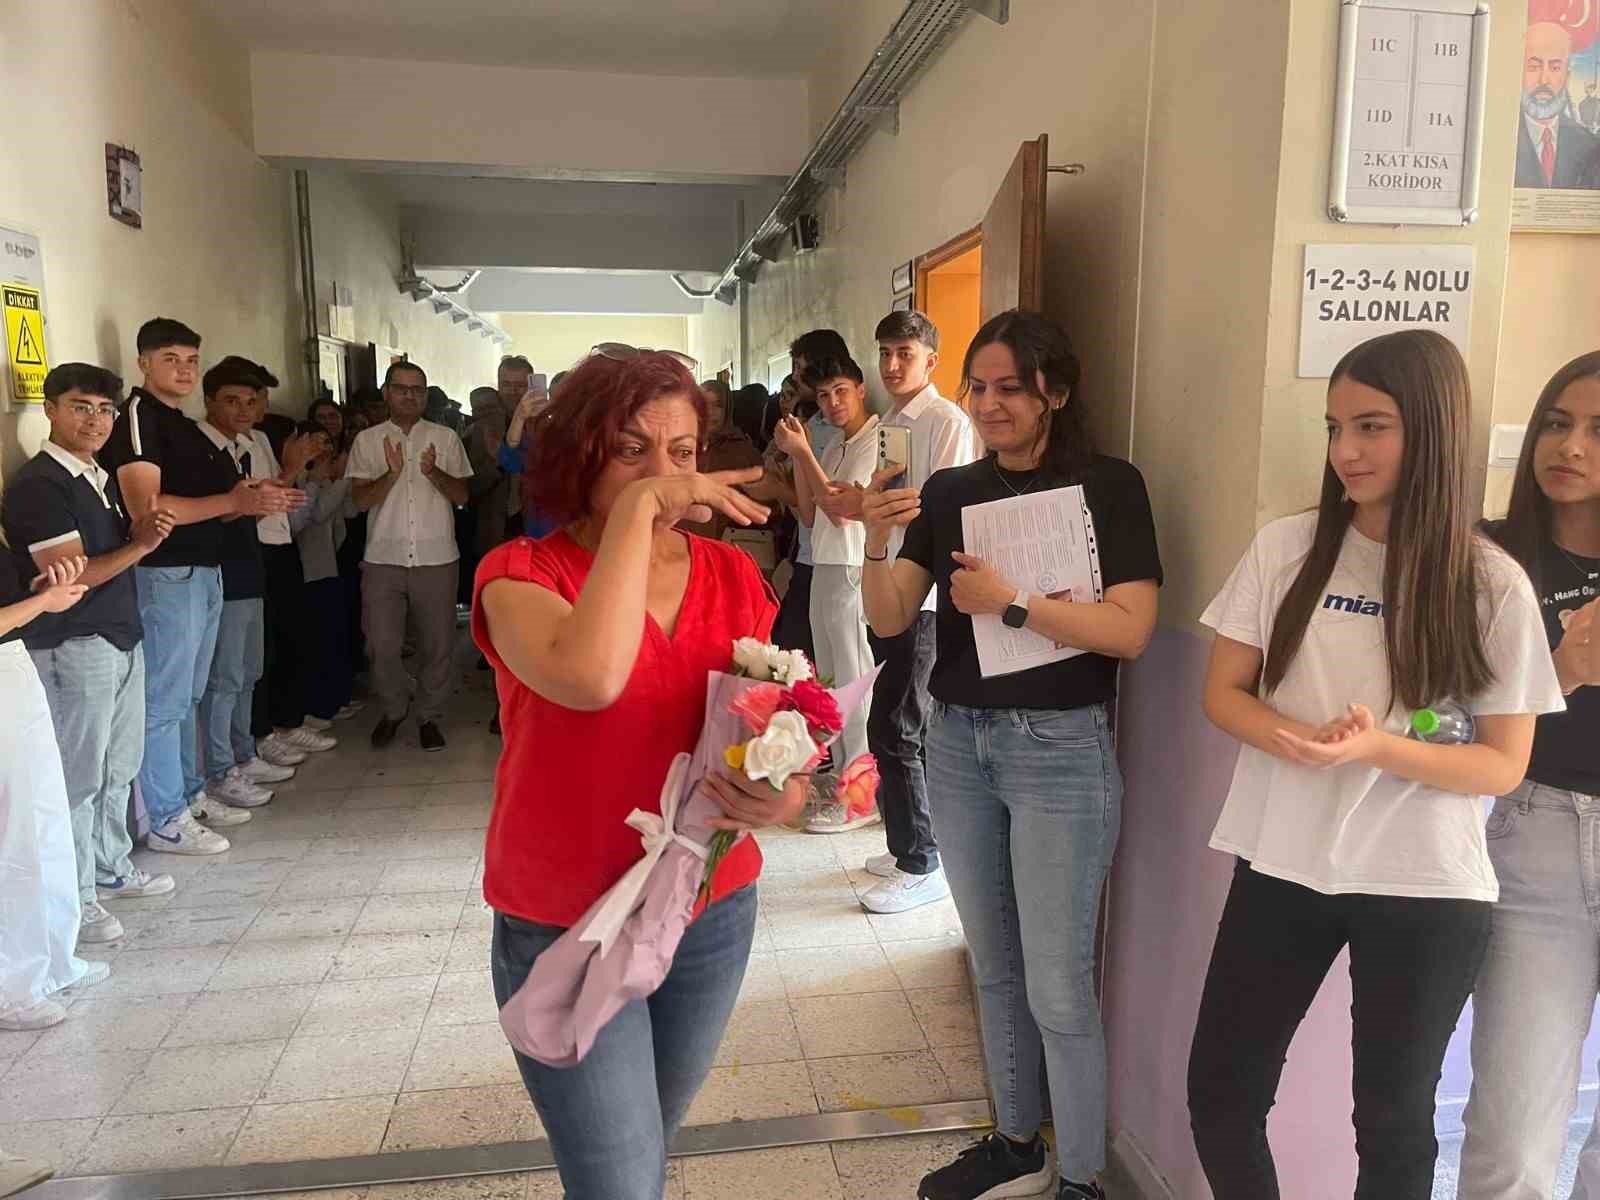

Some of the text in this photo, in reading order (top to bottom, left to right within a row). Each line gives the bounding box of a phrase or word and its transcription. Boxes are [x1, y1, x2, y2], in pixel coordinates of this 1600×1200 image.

[1371, 38, 1398, 53] 11C
[1433, 43, 1459, 57] 11B
[1367, 109, 1393, 124] 11D
[1428, 112, 1454, 127] 11A
[1363, 152, 1449, 170] 2.KAT KISA
[1367, 171, 1442, 190] KORİDOR
[1305, 268, 1470, 292] 1-2-3-4 NOLU
[8, 291, 34, 309] DİKKAT
[1318, 299, 1450, 323] SALONLAR
